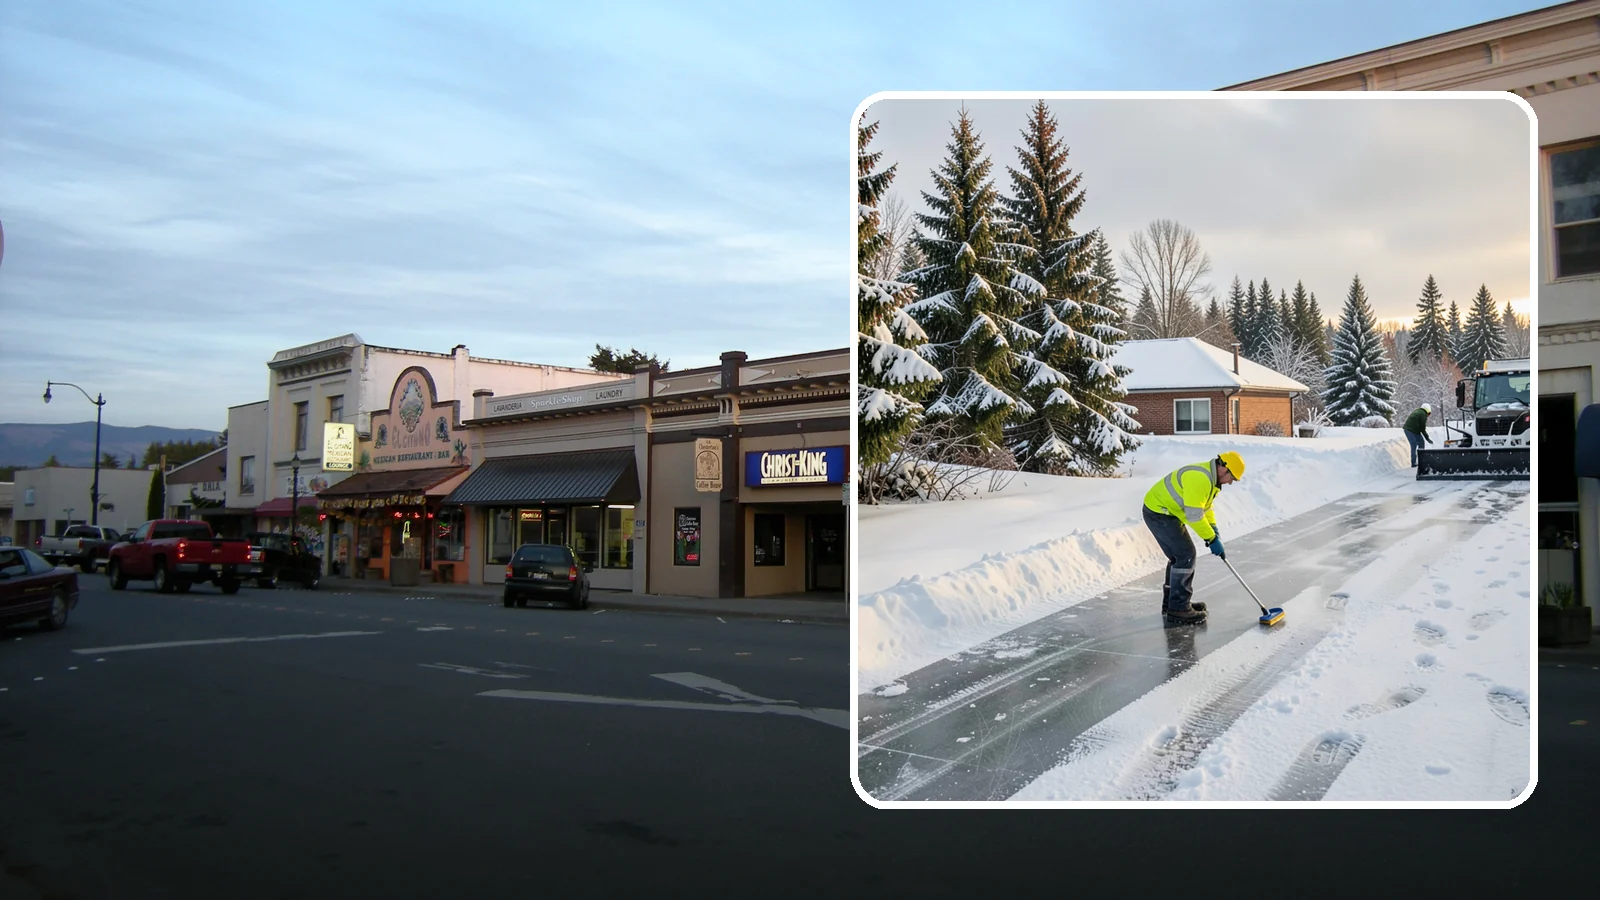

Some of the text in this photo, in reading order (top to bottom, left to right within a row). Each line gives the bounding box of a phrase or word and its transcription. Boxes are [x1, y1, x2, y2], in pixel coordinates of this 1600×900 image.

[595, 389, 623, 400] LAUNDRY
[493, 402, 523, 413] LAVANDERIA
[530, 395, 582, 409] Sparkle Shop
[373, 455, 396, 464] MEXICAN
[397, 451, 433, 462] RESTAURANT
[438, 450, 450, 459] BAR
[761, 450, 827, 478] CHRIST KING
